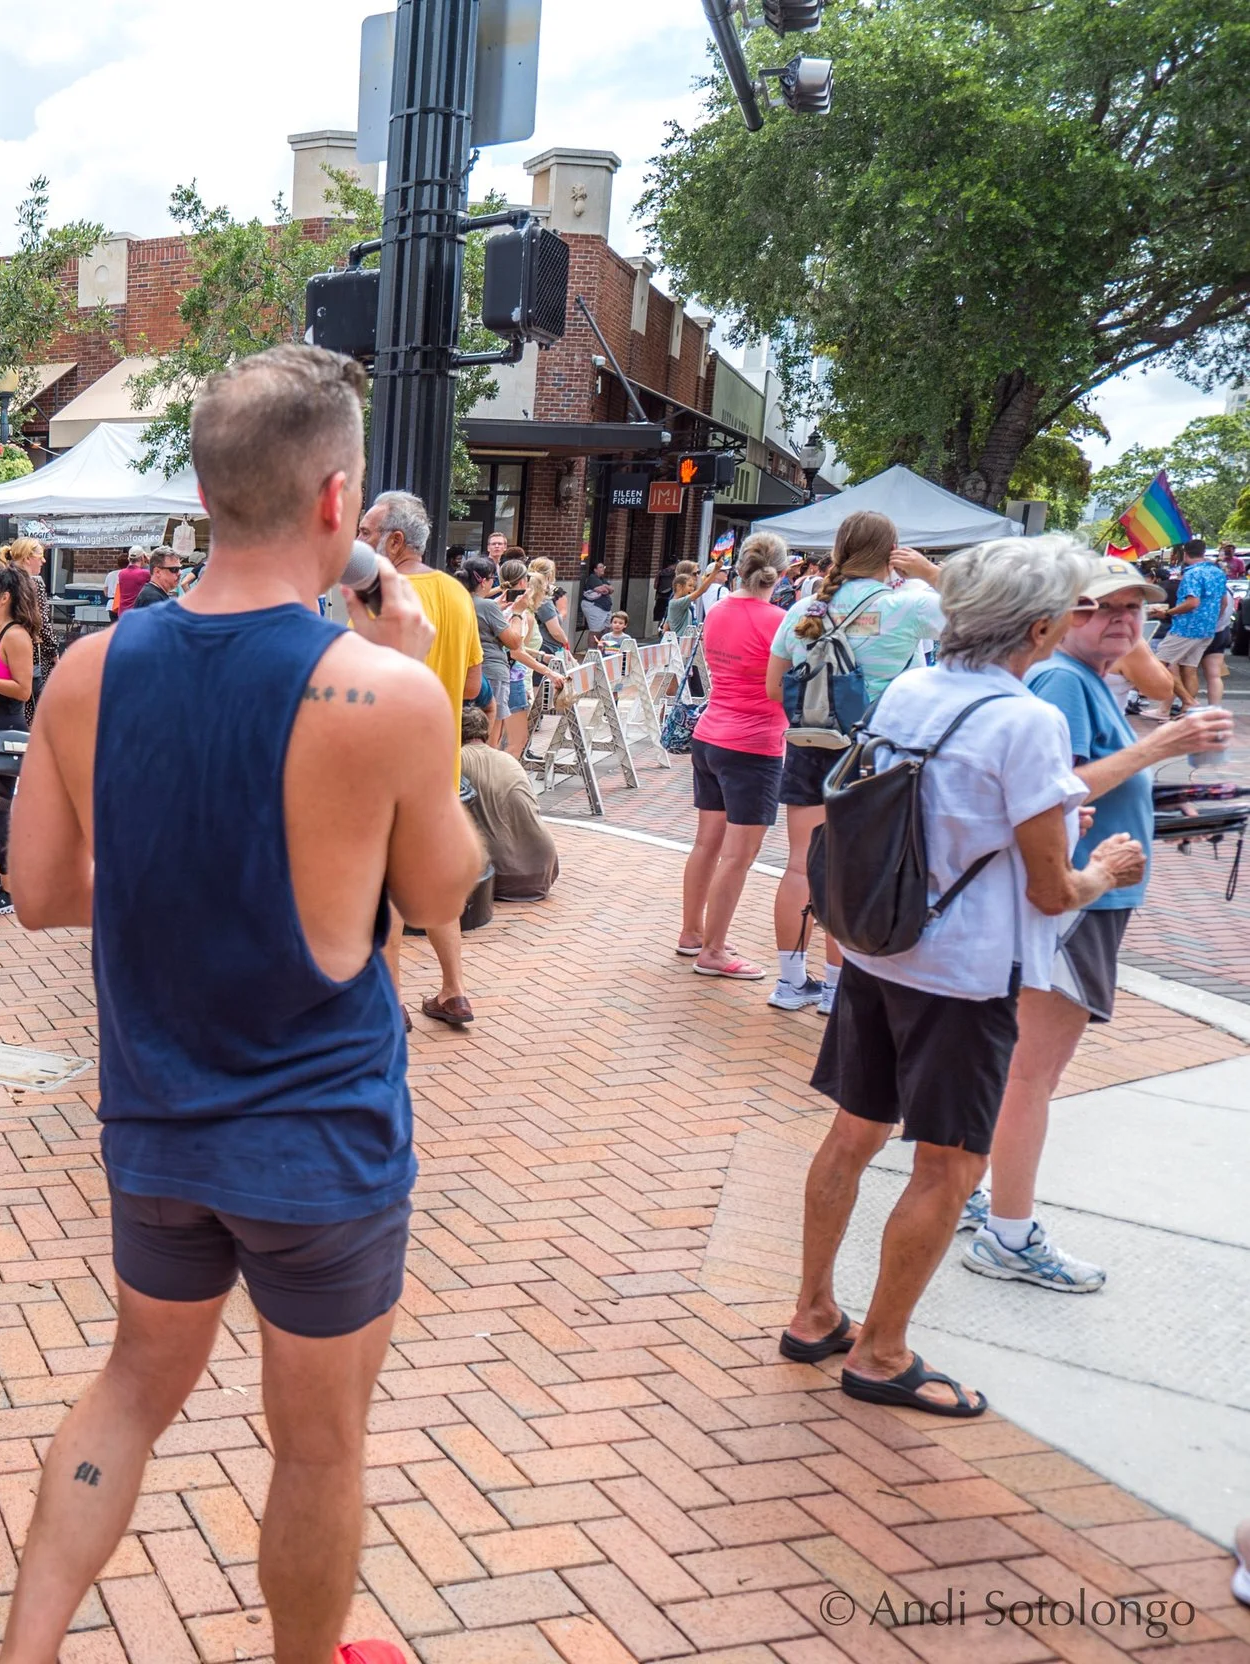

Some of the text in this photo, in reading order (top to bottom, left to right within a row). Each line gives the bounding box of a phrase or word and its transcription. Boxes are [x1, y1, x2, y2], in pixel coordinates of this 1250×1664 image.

[612, 489, 643, 498] EILEEN
[612, 497, 642, 505] FISHER
[57, 533, 163, 545] www.MaggiesSeafood.co
